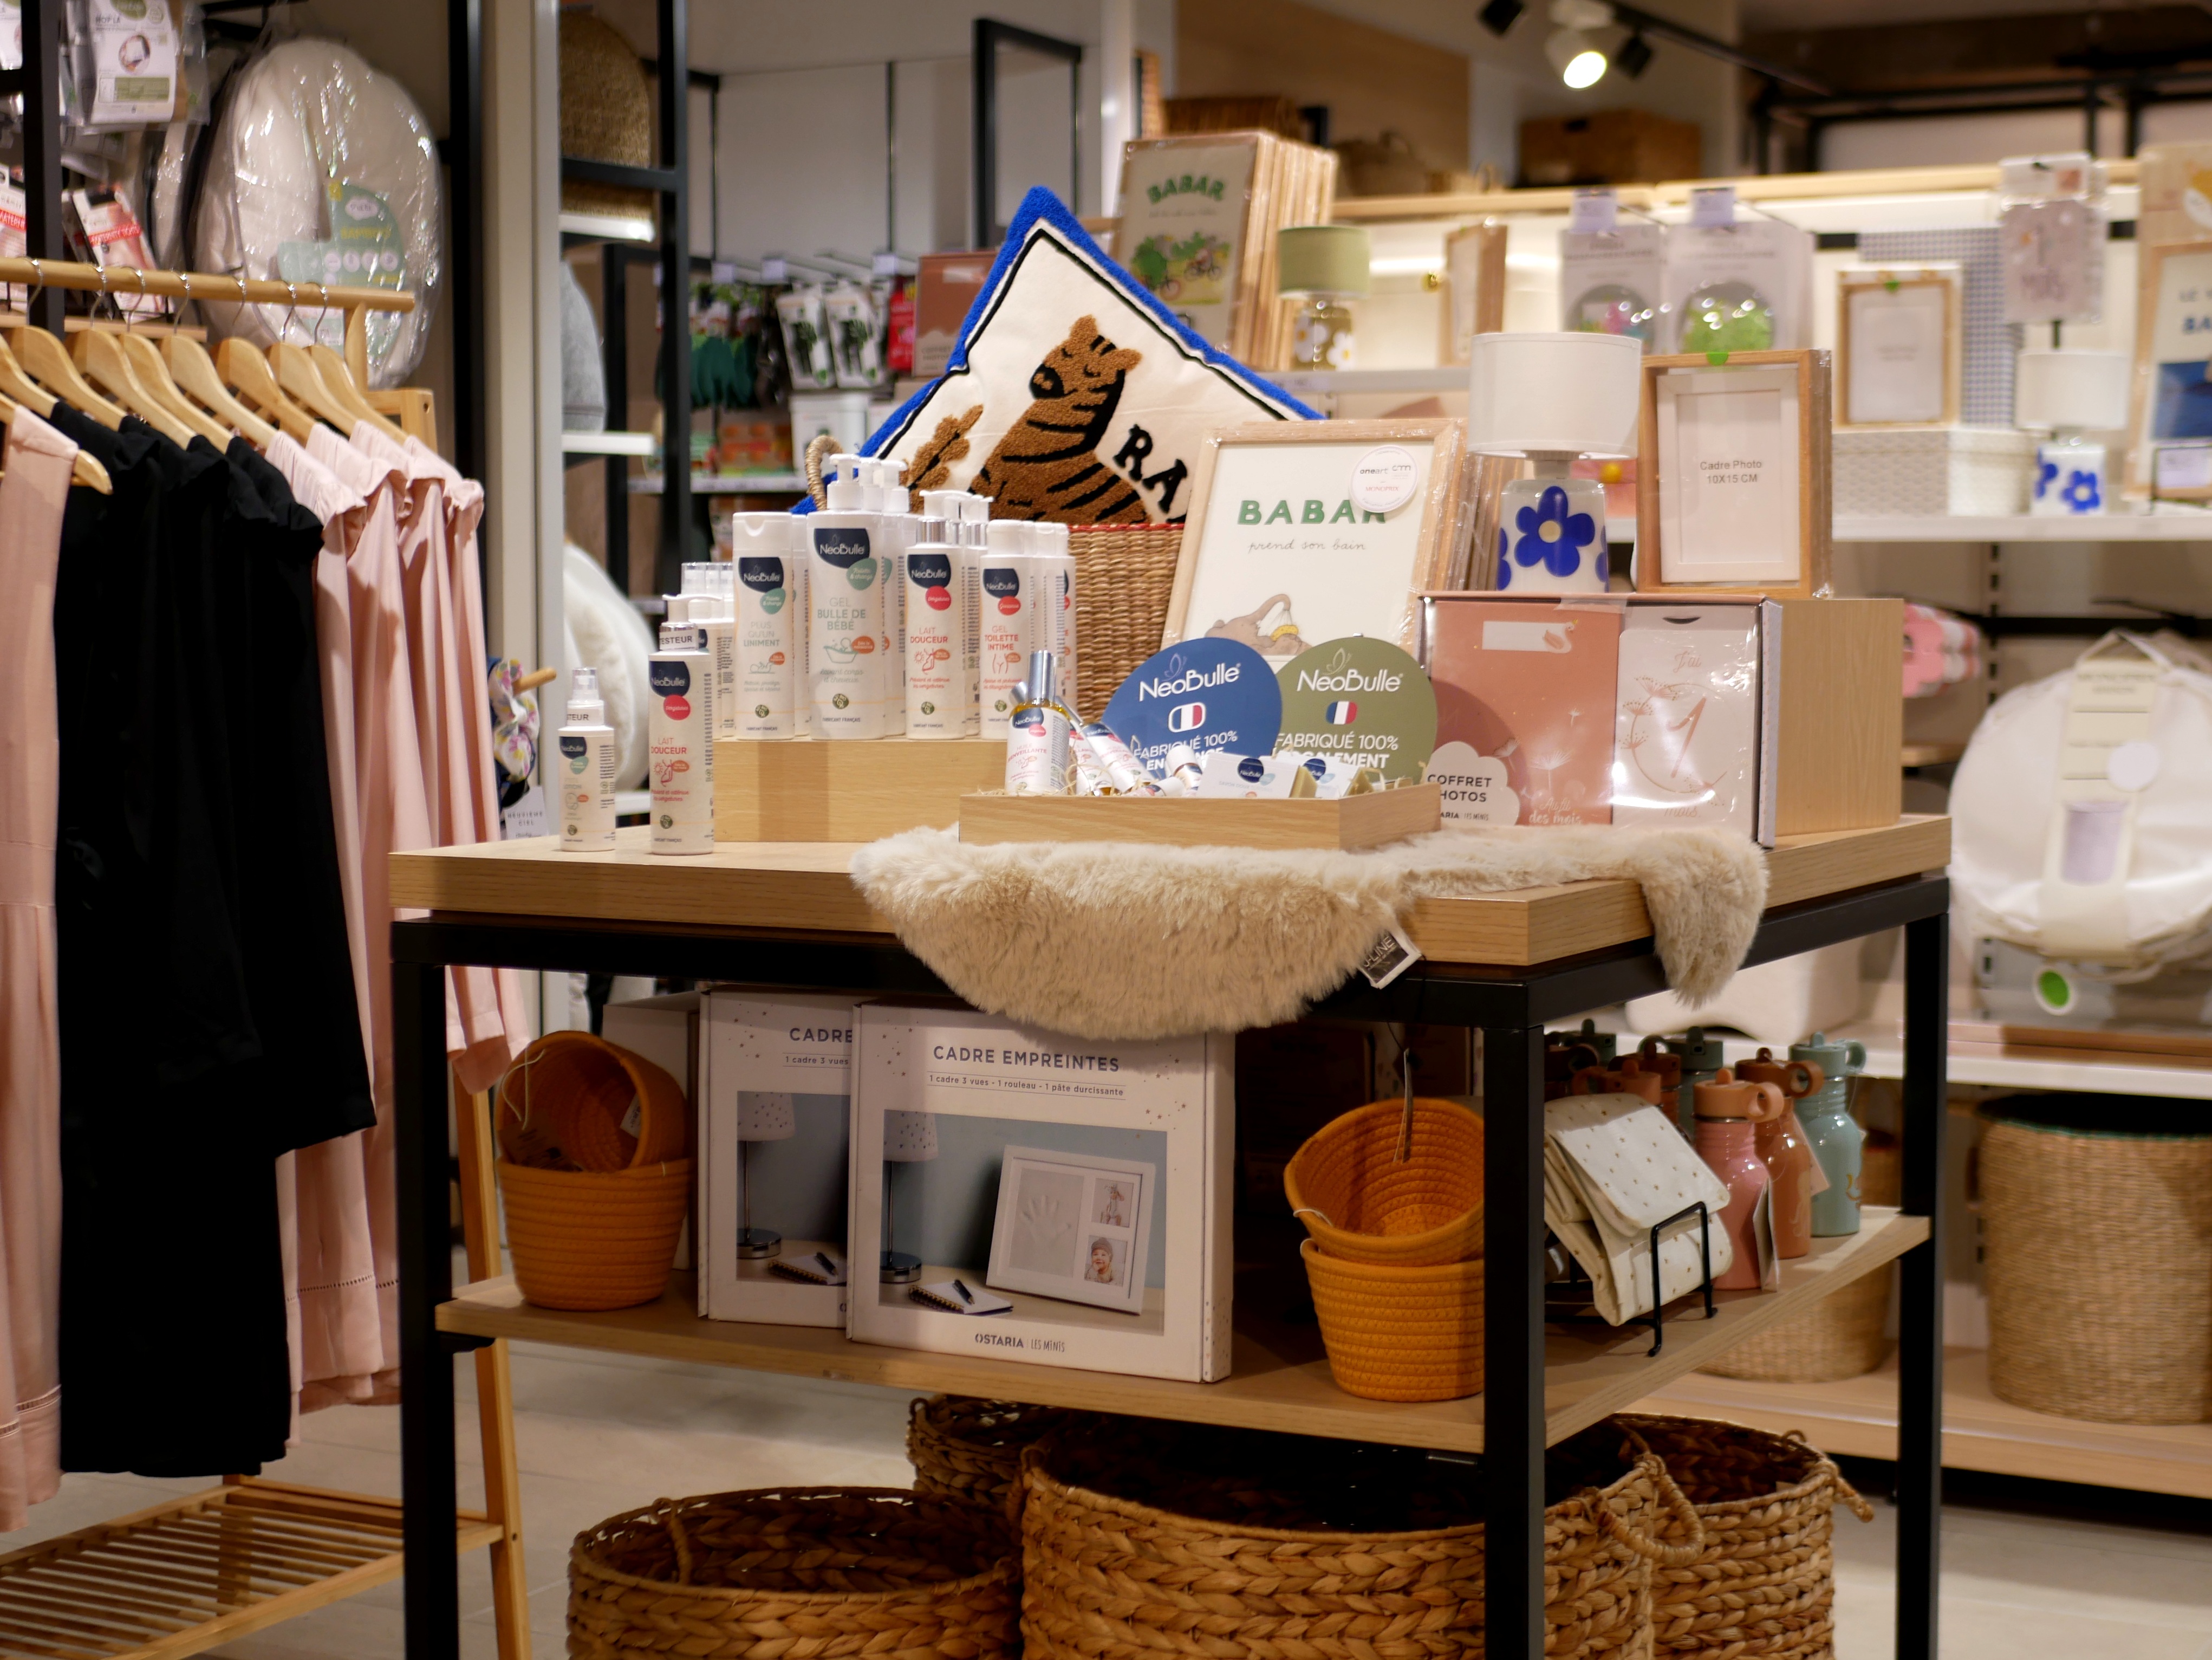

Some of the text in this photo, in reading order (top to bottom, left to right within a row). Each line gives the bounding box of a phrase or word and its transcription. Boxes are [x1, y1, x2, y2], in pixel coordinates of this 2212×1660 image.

[1147, 174, 1224, 204] BABAR
[1700, 460, 1762, 471] Cadre Photo
[1113, 424, 1187, 523] RA
[1707, 474, 1758, 484] 10X15 CM
[819, 543, 864, 555] NeoBulle
[1248, 537, 1367, 554] prend son bain
[744, 572, 780, 582] NeoBulle
[911, 569, 947, 579] NeoBulle
[829, 597, 851, 607] GEL
[817, 609, 866, 619] BULLE DE
[827, 618, 854, 630] BÉBÉ
[1138, 662, 1240, 702] NeoBulle
[1297, 669, 1402, 692] NeoBulle
[1205, 730, 1238, 748] 100%
[1276, 731, 1399, 750] FABRIQUÉ 100%
[1146, 758, 1164, 771] EN
[1427, 774, 1492, 788] COFFRET
[1440, 789, 1487, 803] HOTOS
[1440, 811, 1459, 819] ARIA
[1364, 936, 1395, 968] J-LINE
[789, 1027, 853, 1043] CADRE
[933, 1046, 1120, 1072] CADRE EMPREINTES
[936, 1075, 959, 1084] cadre
[970, 1078, 989, 1086] vues
[1004, 1080, 1036, 1090] rouleau
[1051, 1082, 1071, 1093] pâte
[1074, 1085, 1123, 1096] durcissante
[974, 1333, 1024, 1348] OSTARIA
[1031, 1339, 1042, 1350] LES
